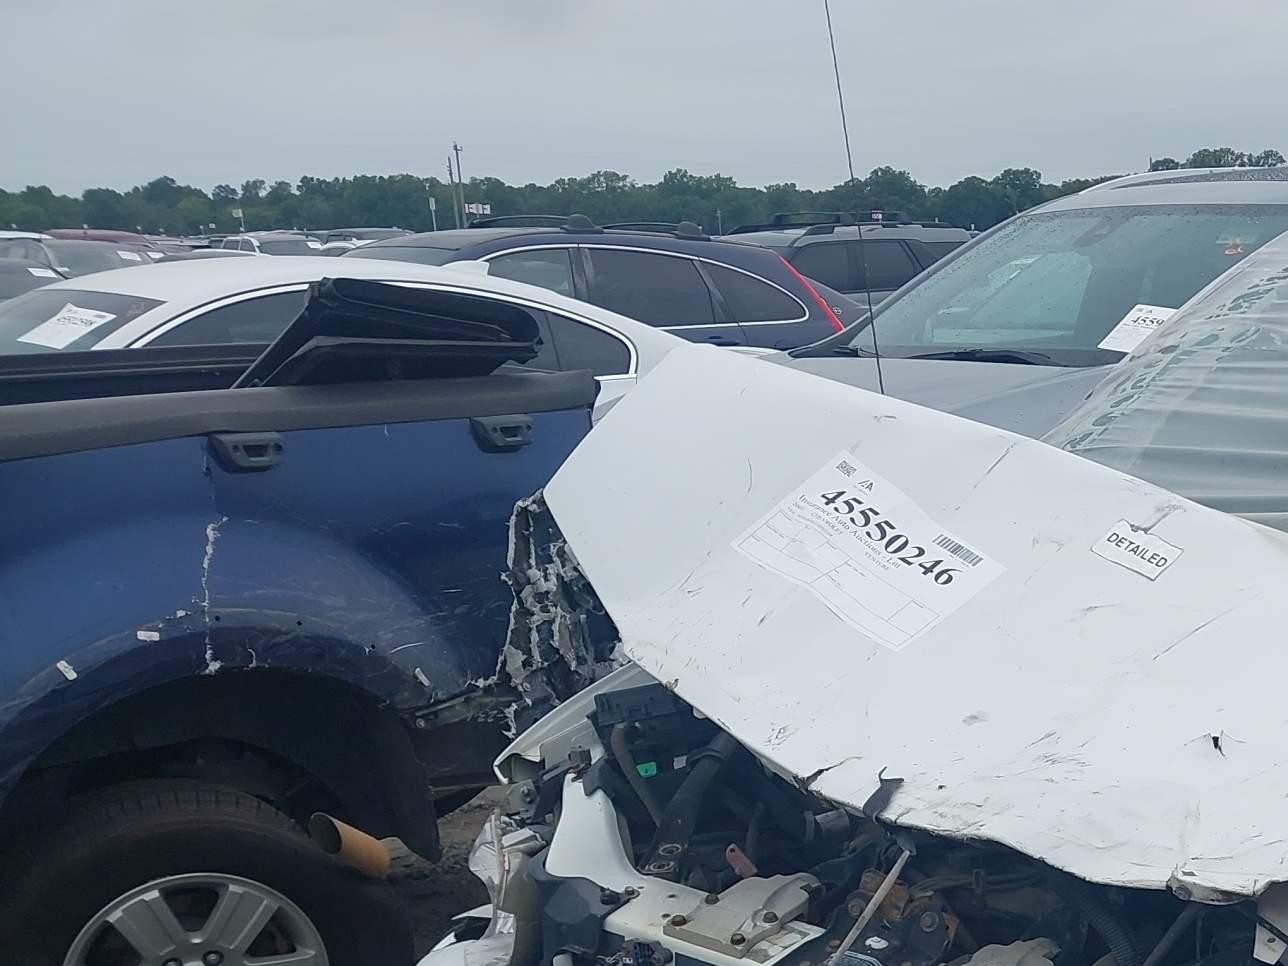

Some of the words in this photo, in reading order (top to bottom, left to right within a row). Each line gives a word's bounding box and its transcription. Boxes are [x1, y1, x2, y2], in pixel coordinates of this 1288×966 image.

[799, 494, 832, 517] Insurance
[830, 515, 850, 531] Auto
[848, 530, 882, 556] Auctions
[821, 490, 963, 585] 45550246
[1106, 532, 1168, 568] DETAILED
